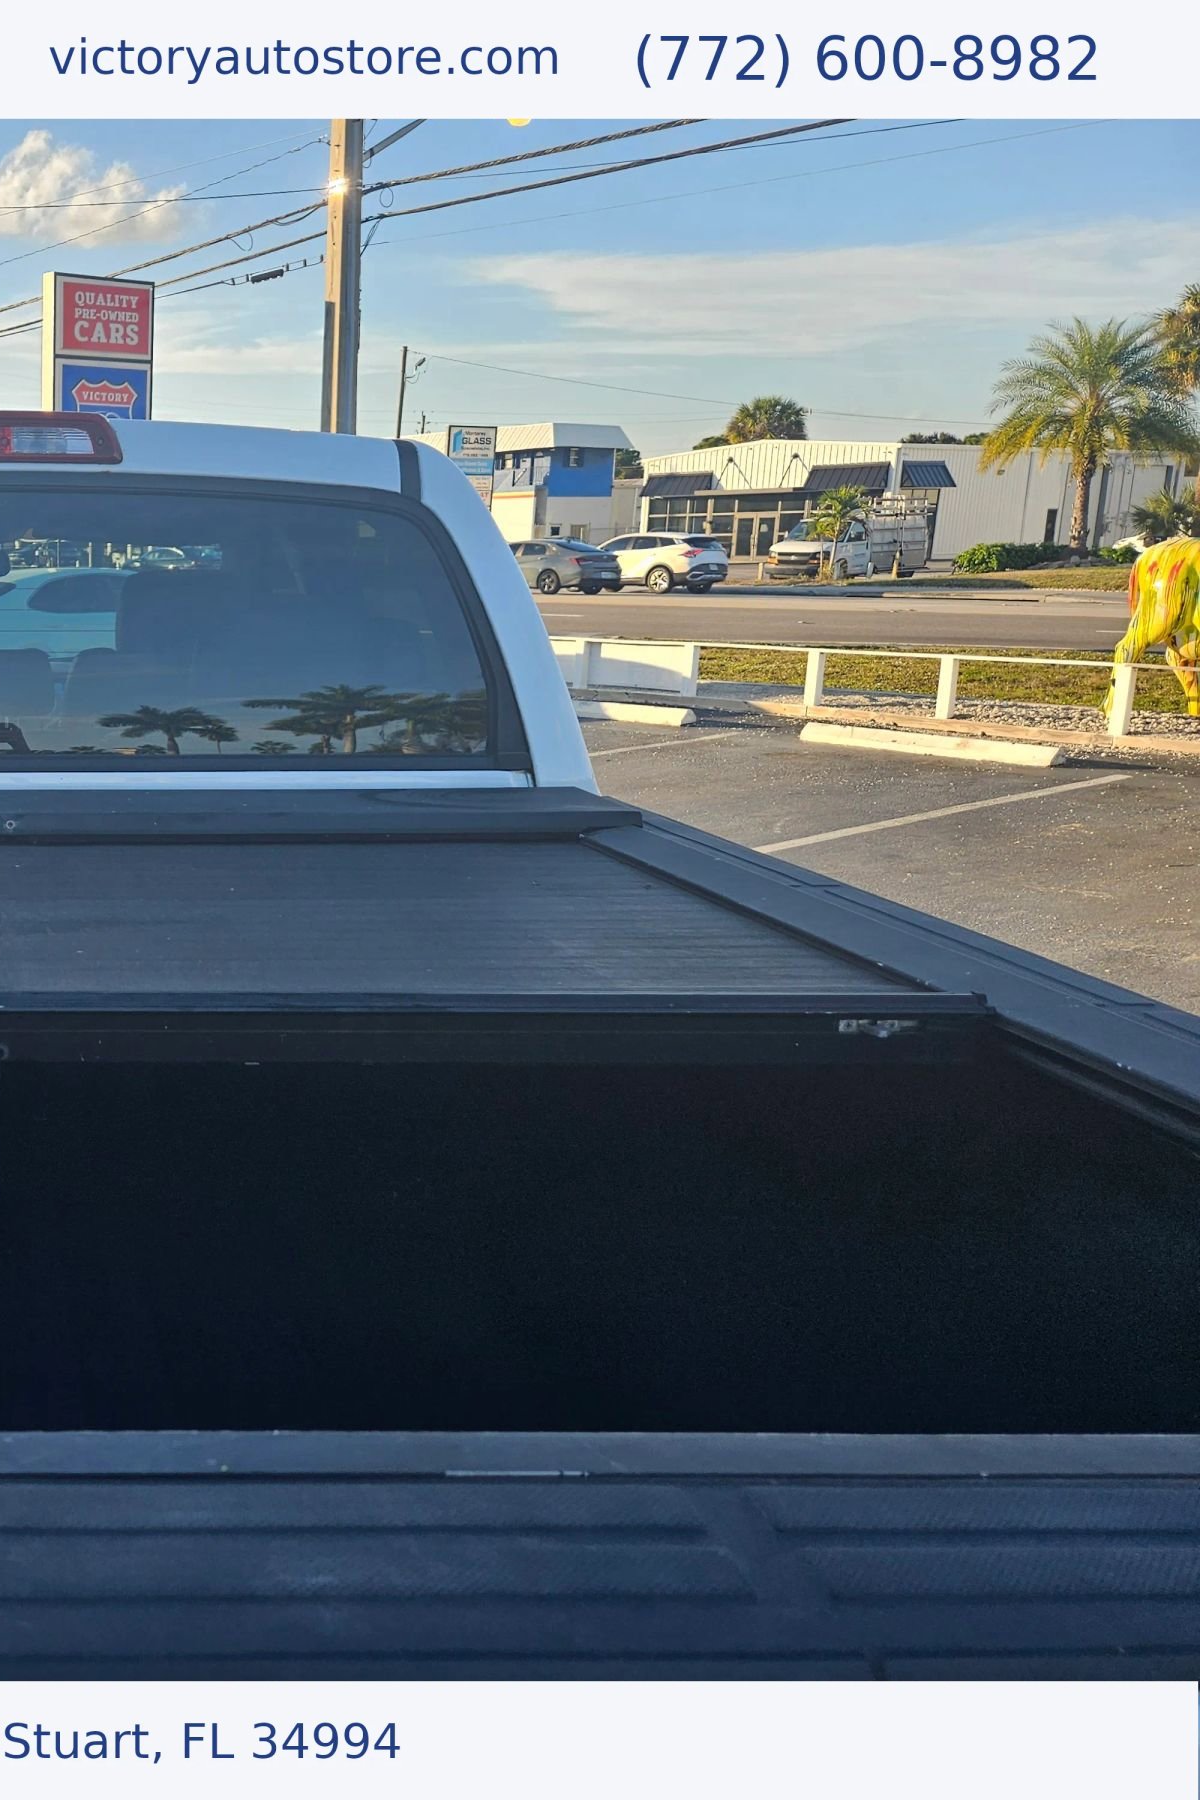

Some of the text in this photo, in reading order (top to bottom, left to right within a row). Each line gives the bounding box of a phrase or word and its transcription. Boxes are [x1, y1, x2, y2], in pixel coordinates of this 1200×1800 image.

[74, 291, 139, 309] QUALITY
[74, 308, 139, 323] PRE-OWNED
[74, 321, 139, 345] CARS
[81, 391, 130, 402] VICTORY
[461, 437, 492, 445] GLASS
